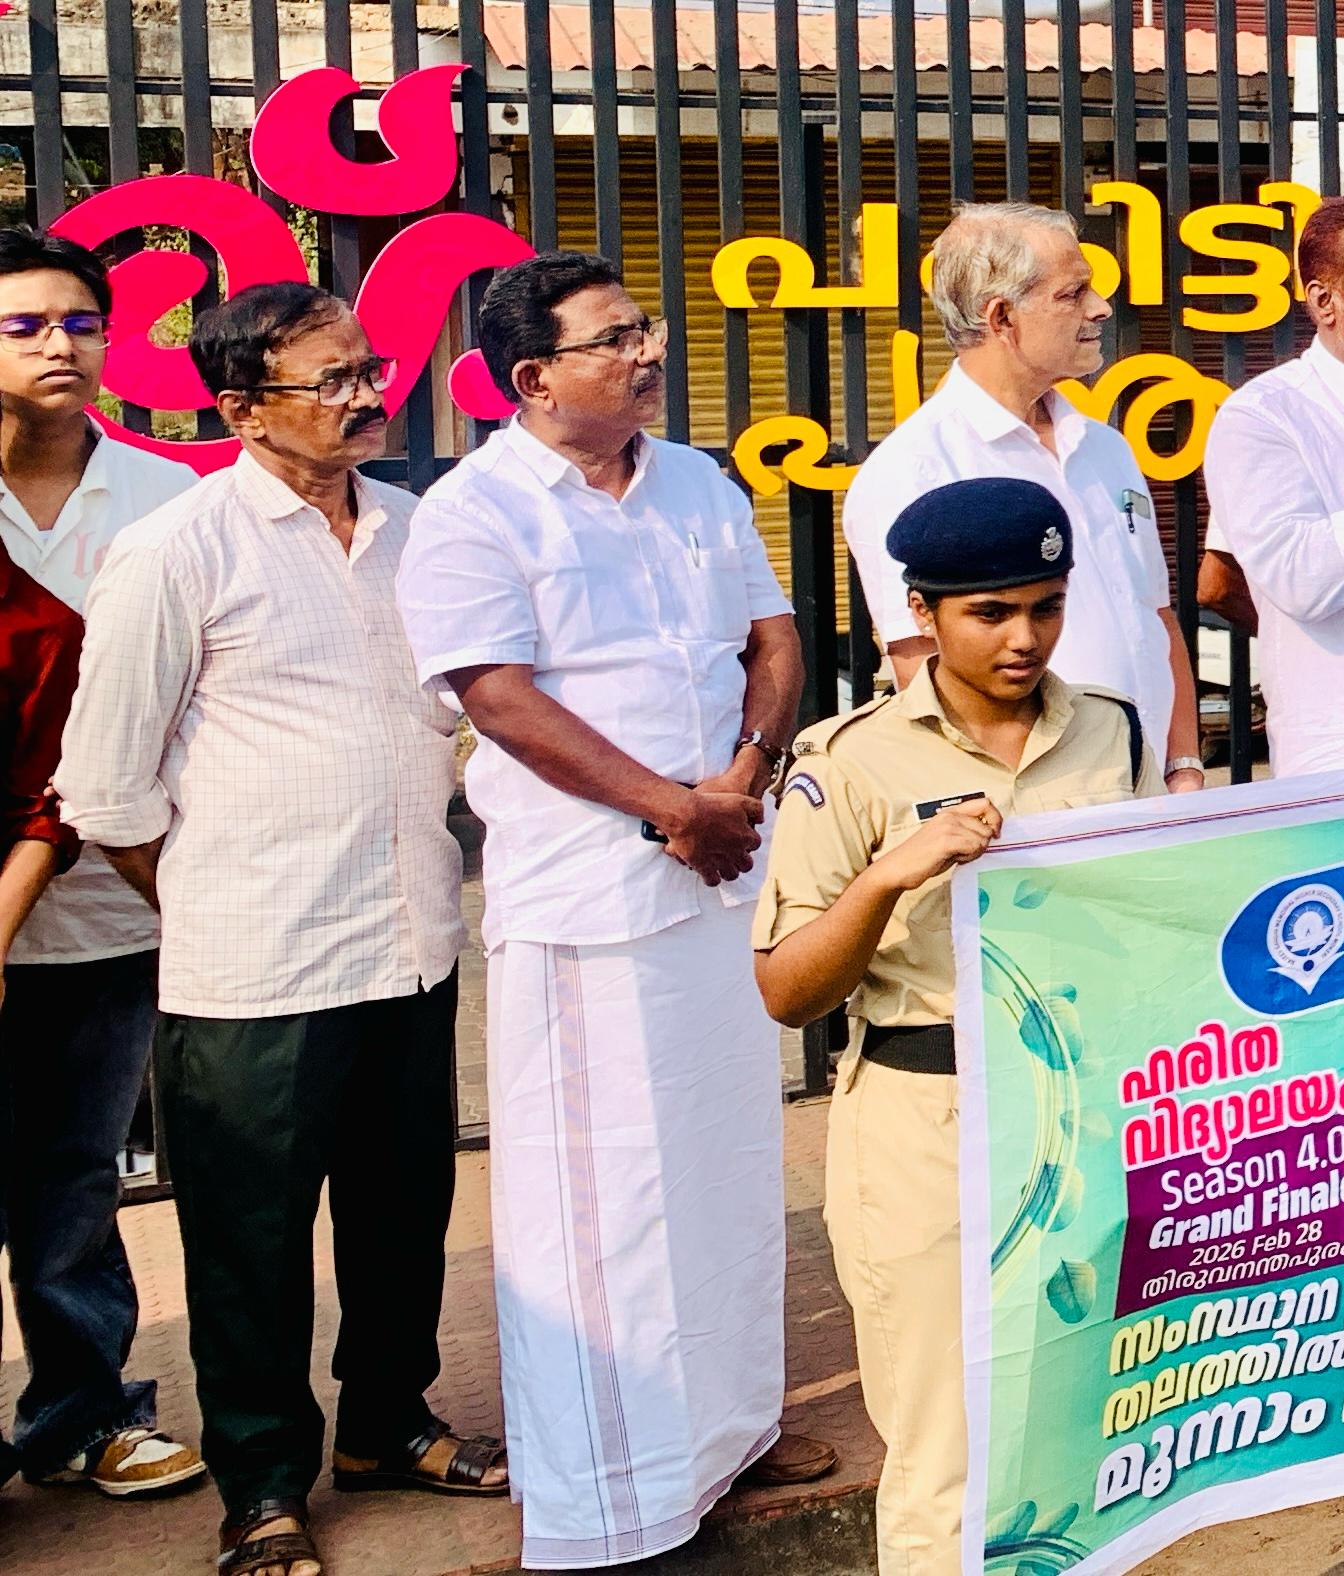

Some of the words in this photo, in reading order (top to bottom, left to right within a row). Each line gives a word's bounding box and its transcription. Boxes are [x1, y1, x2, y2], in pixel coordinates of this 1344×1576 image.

[1121, 1021, 1280, 1106] ഹരിത
[1161, 1149, 1286, 1211] Season
[1149, 1193, 1254, 1250] Grand
[1188, 1241, 1245, 1267] 2026
[1251, 1228, 1290, 1256] Feb
[1295, 1220, 1323, 1243] 28
[1109, 1277, 1340, 1376] സംസ്ഥാന
[1094, 1391, 1327, 1513] മൂന്നാം
